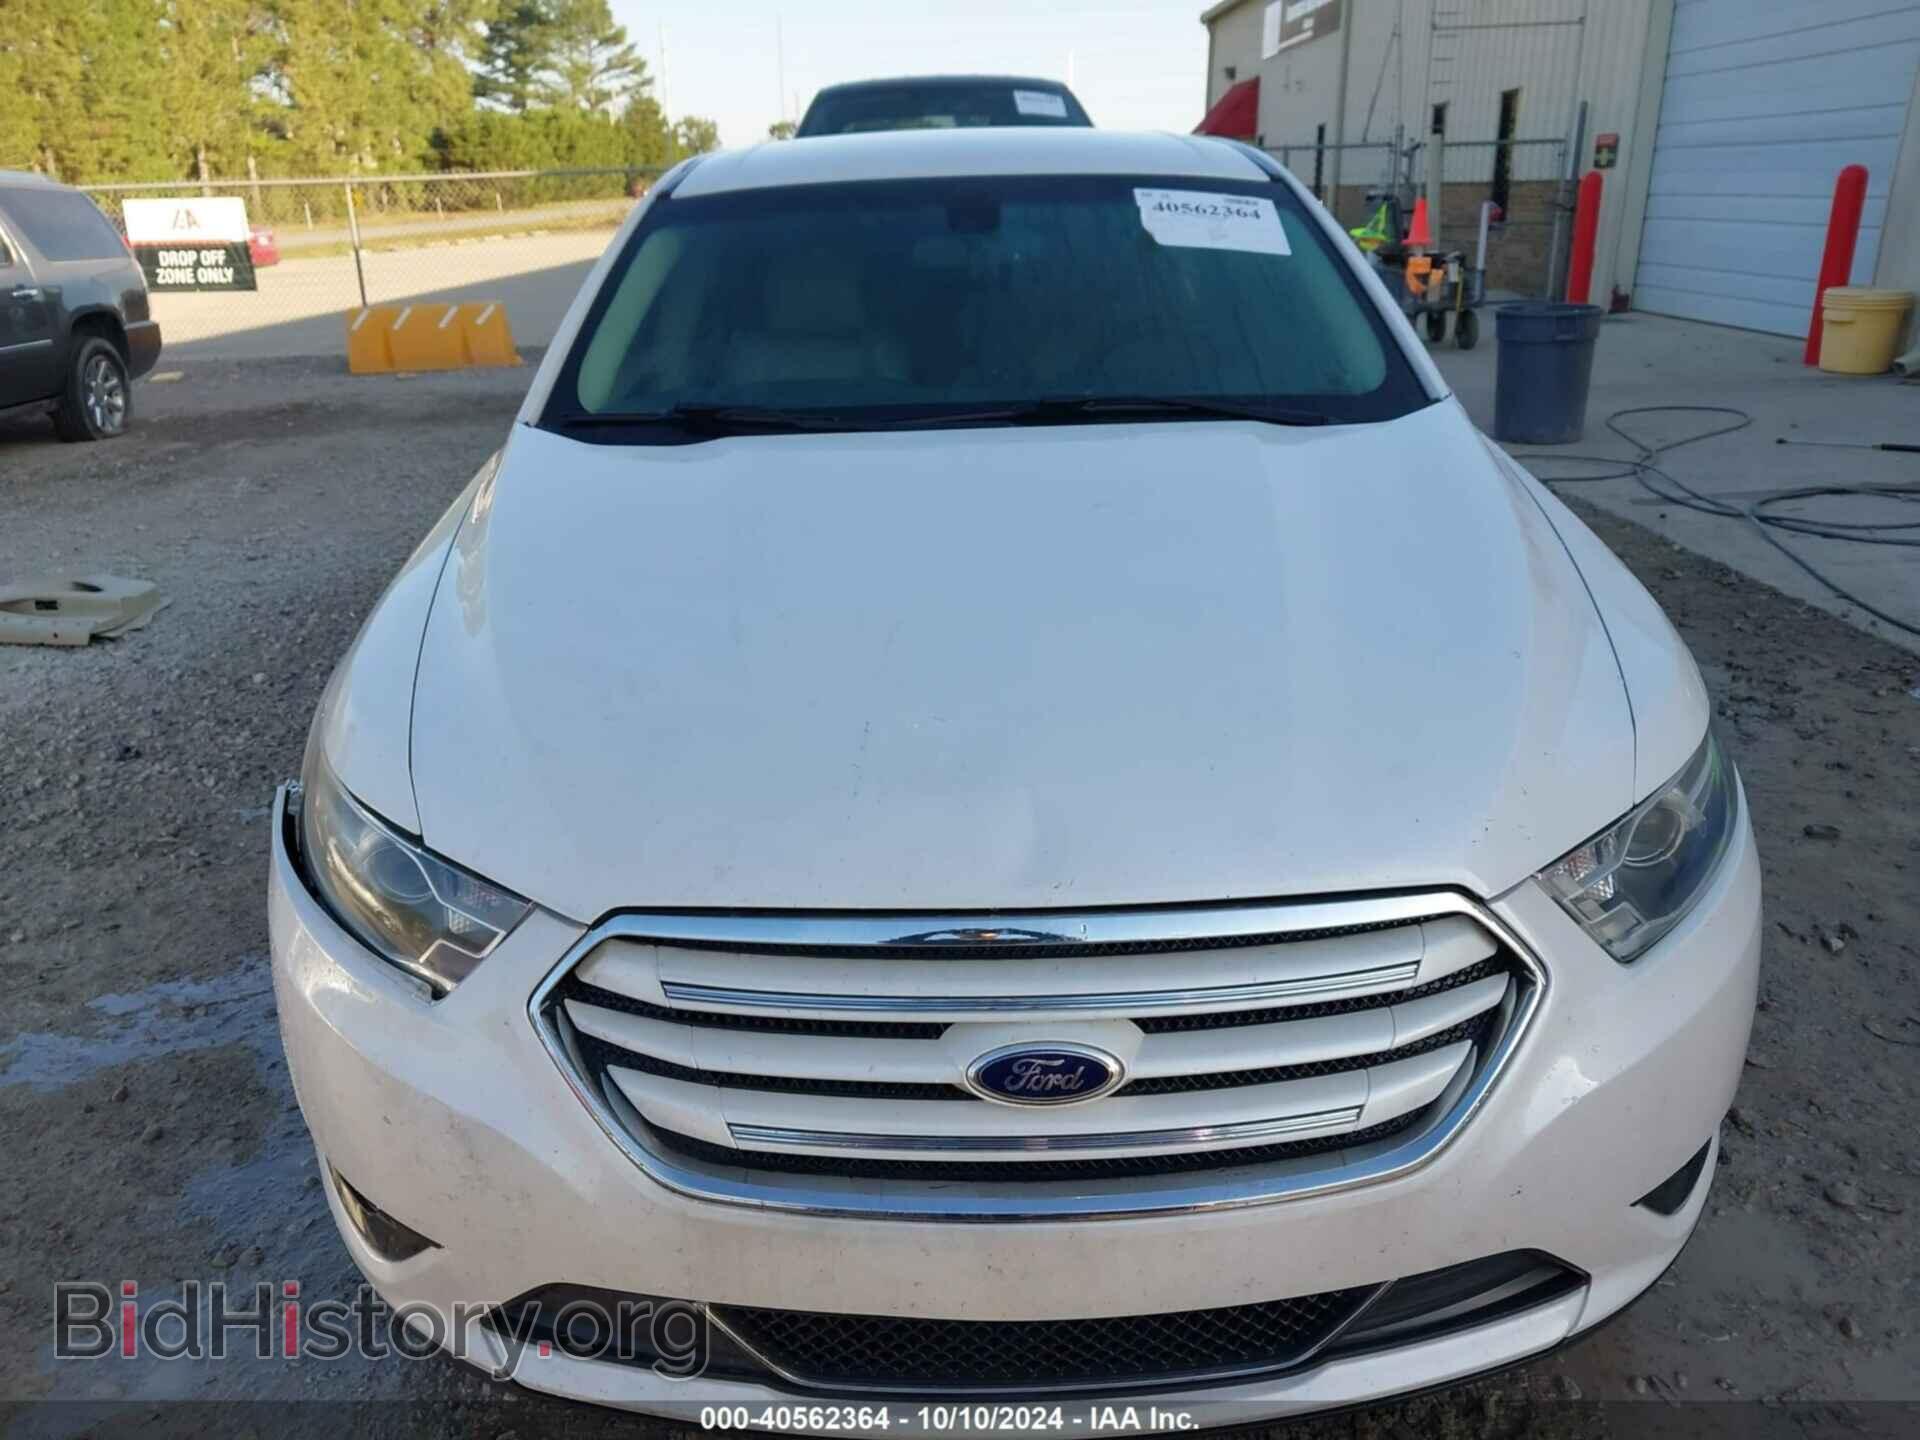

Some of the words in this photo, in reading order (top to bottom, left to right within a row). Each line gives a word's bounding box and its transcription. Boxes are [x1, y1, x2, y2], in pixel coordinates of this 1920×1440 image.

[1152, 201, 1261, 220] 40562364
[158, 250, 197, 267] DROP
[199, 250, 226, 266] OFF
[156, 268, 196, 284] ZONE
[197, 267, 234, 284] ONLY
[1004, 1058, 1086, 1091] Ford
